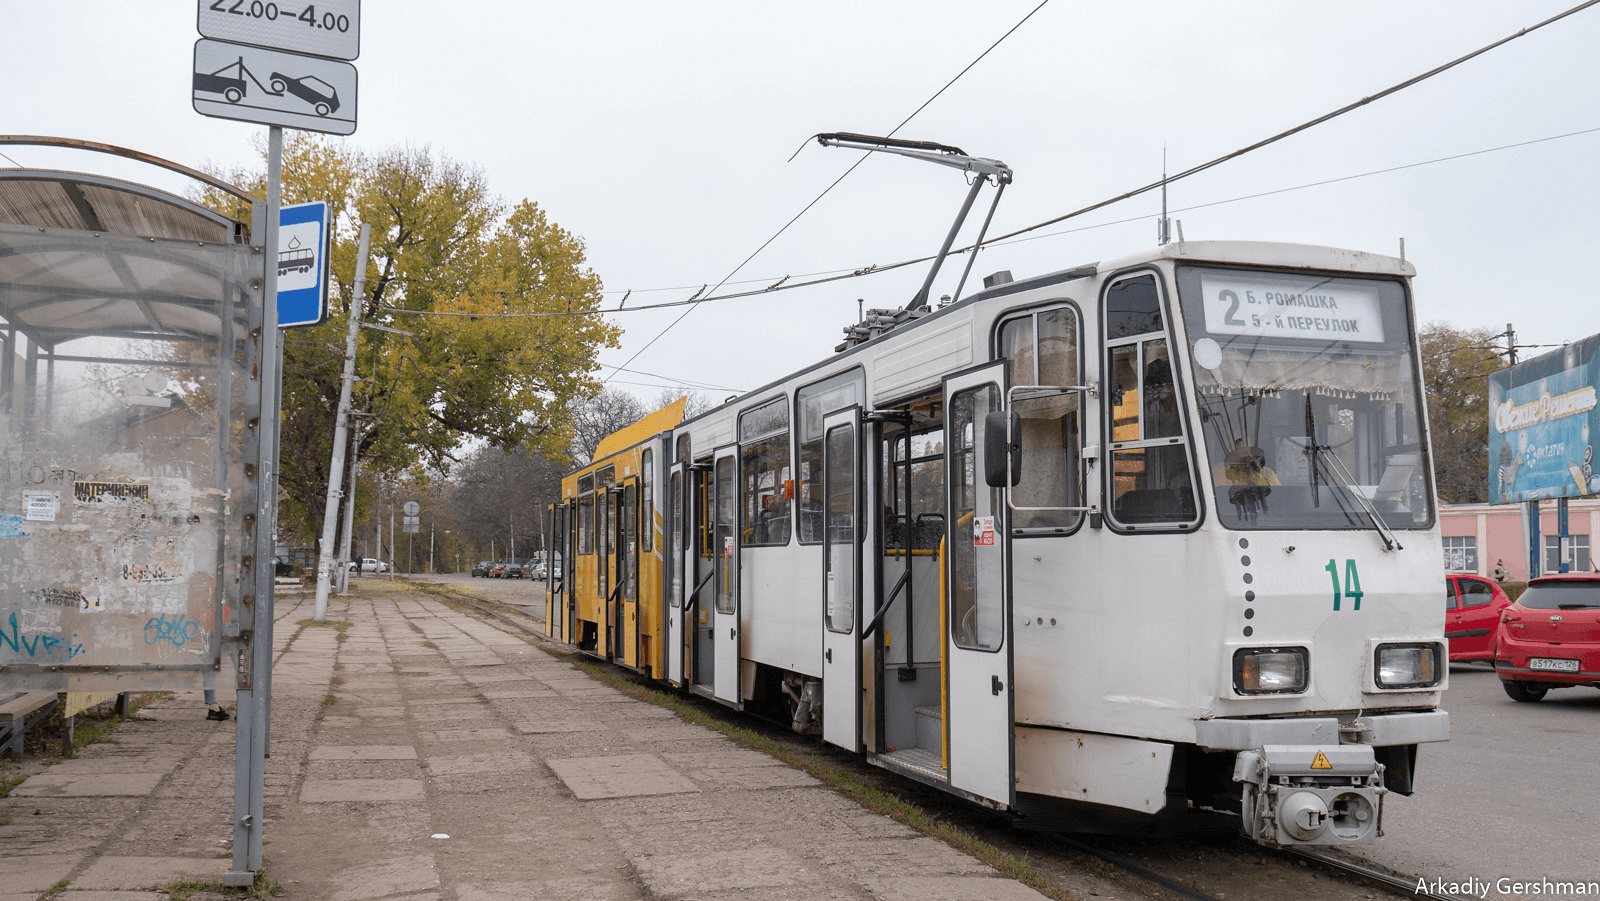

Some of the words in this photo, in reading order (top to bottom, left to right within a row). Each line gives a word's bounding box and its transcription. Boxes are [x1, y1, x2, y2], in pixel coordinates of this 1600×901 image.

[1218, 289, 1246, 327] 2
[1246, 290, 1262, 305] Б.
[1265, 291, 1339, 310] РОМАШКА
[1287, 315, 1360, 333] ПЕРЕУЛОК
[1325, 559, 1364, 611] 14
